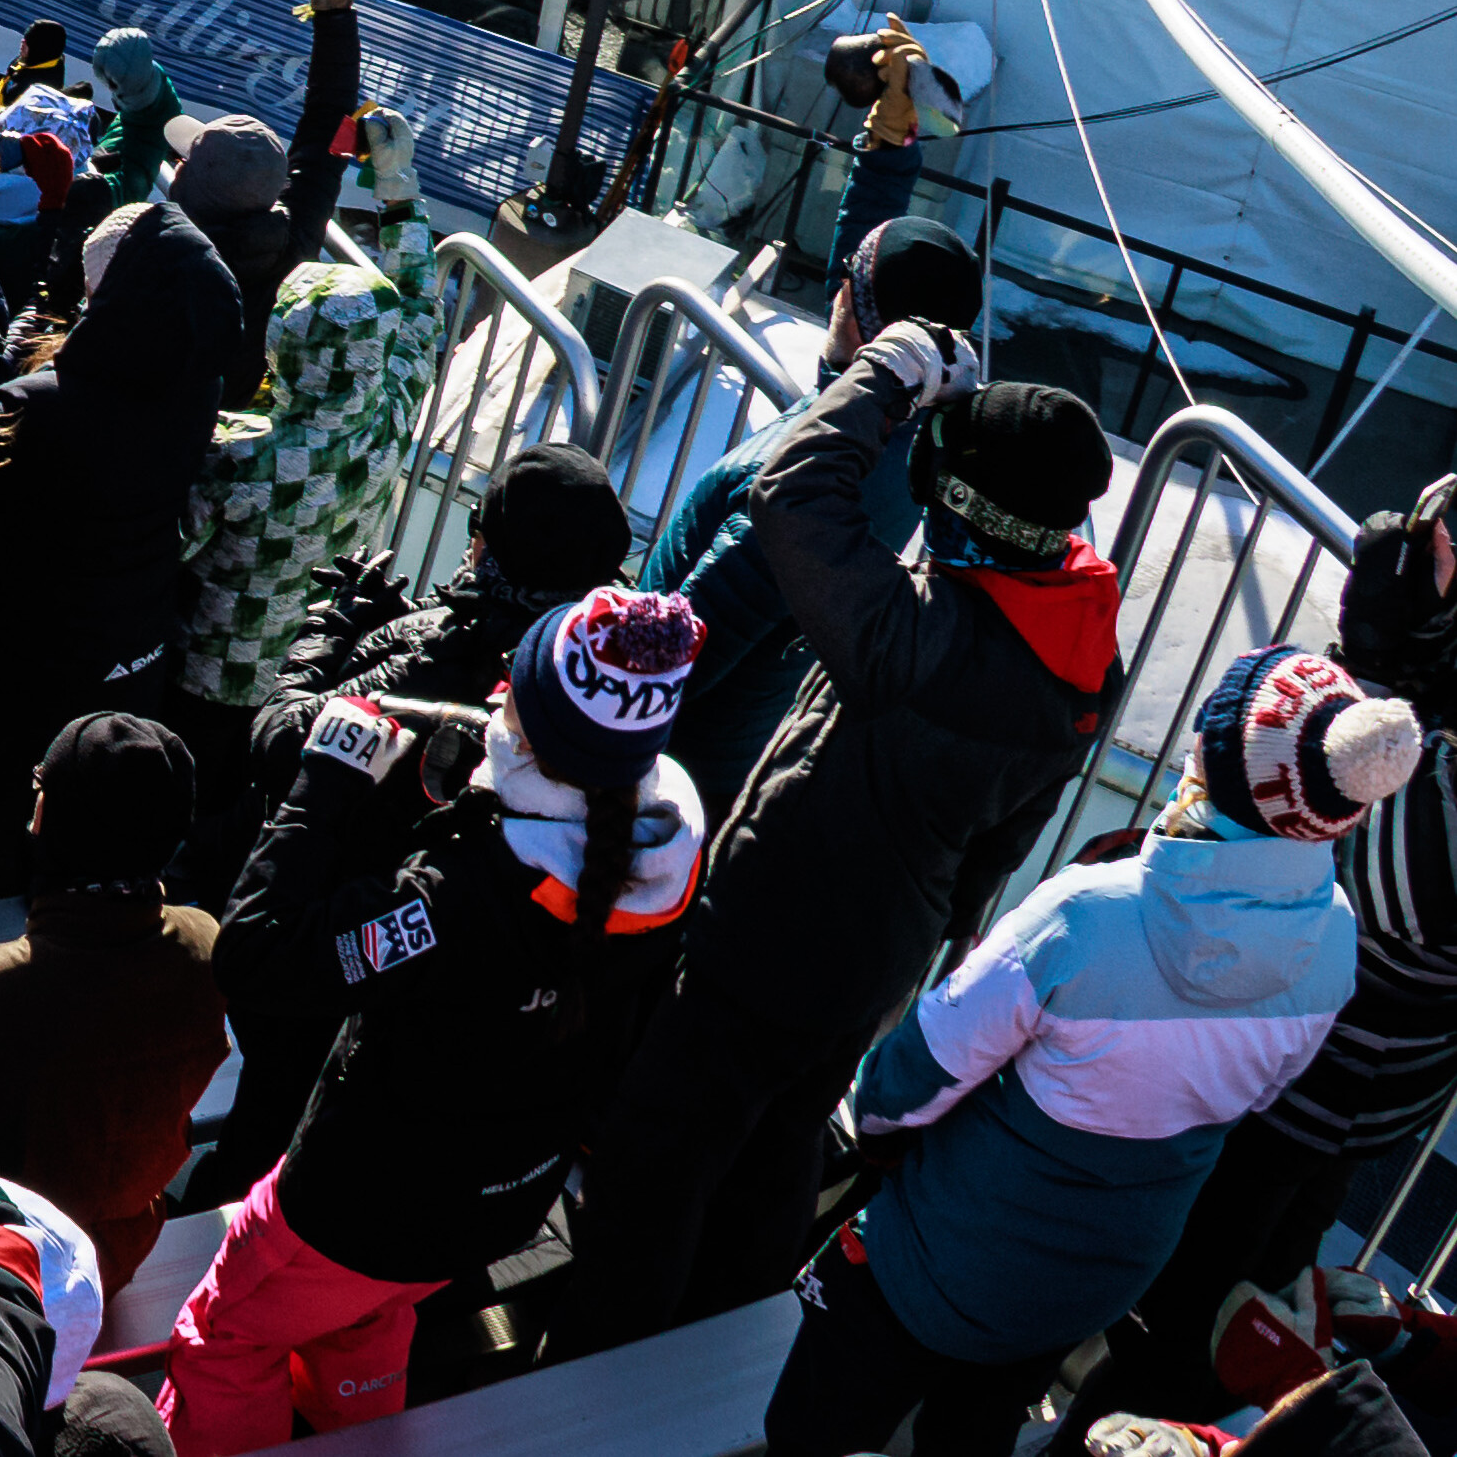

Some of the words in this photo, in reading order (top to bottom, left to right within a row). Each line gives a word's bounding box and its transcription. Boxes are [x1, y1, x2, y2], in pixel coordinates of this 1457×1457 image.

[317, 716, 380, 768] USA
[400, 902, 432, 950] US
[335, 935, 354, 984] ASSOCIATION
[482, 1180, 517, 1196] HELLY
[521, 1154, 560, 1185] HANSEN
